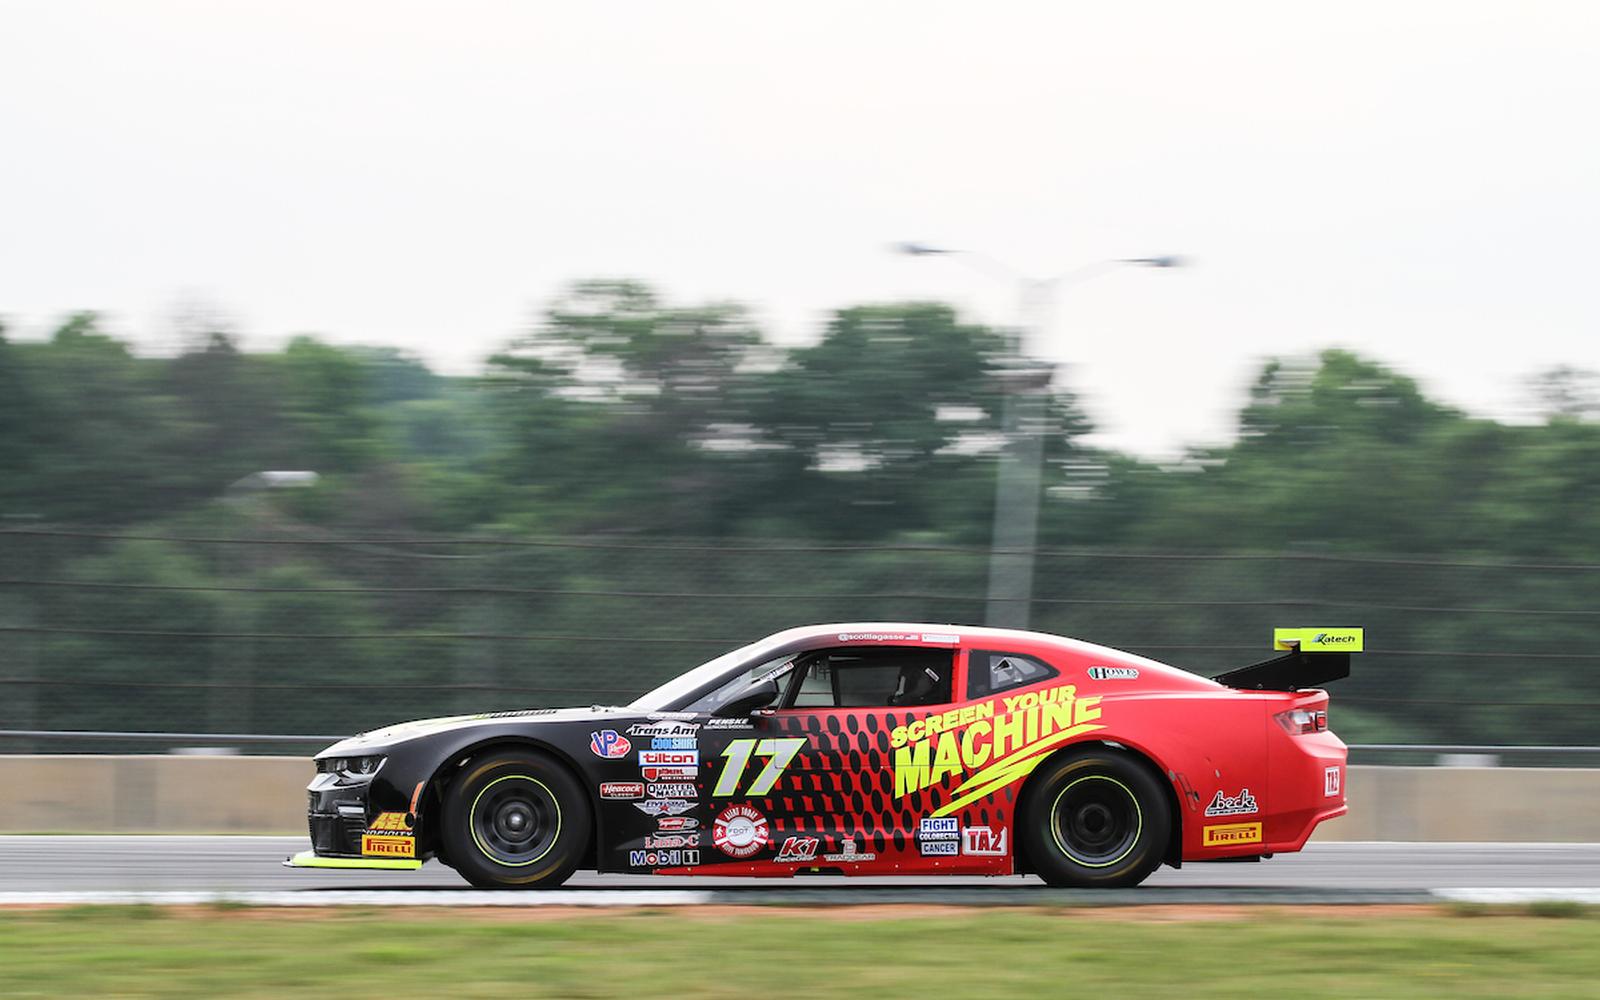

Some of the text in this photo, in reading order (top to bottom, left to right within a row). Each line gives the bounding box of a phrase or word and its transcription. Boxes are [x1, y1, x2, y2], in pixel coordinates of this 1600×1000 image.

[1313, 633, 1355, 645] Katech
[707, 718, 749, 726] PENSKE
[891, 684, 1077, 748] SCREEN YOUR
[632, 725, 694, 735] Trans Am
[592, 731, 618, 756] VP
[895, 696, 1103, 799] MACHINE
[643, 753, 694, 763] tilton
[712, 738, 808, 797] 17
[602, 783, 641, 793] Heacock
[648, 783, 693, 793] QUARTER
[1326, 771, 1339, 793] TA2
[655, 790, 695, 798] MASTER
[1209, 788, 1257, 809] beck
[922, 820, 955, 830] FIGHT
[919, 832, 960, 840] COLORECTAL
[967, 831, 1002, 851] TA2
[1208, 827, 1257, 842] PIRELLI
[366, 838, 411, 854] PIRELLI
[779, 837, 820, 857] K1
[923, 843, 956, 853] CANCER
[630, 850, 680, 866] Mobil
